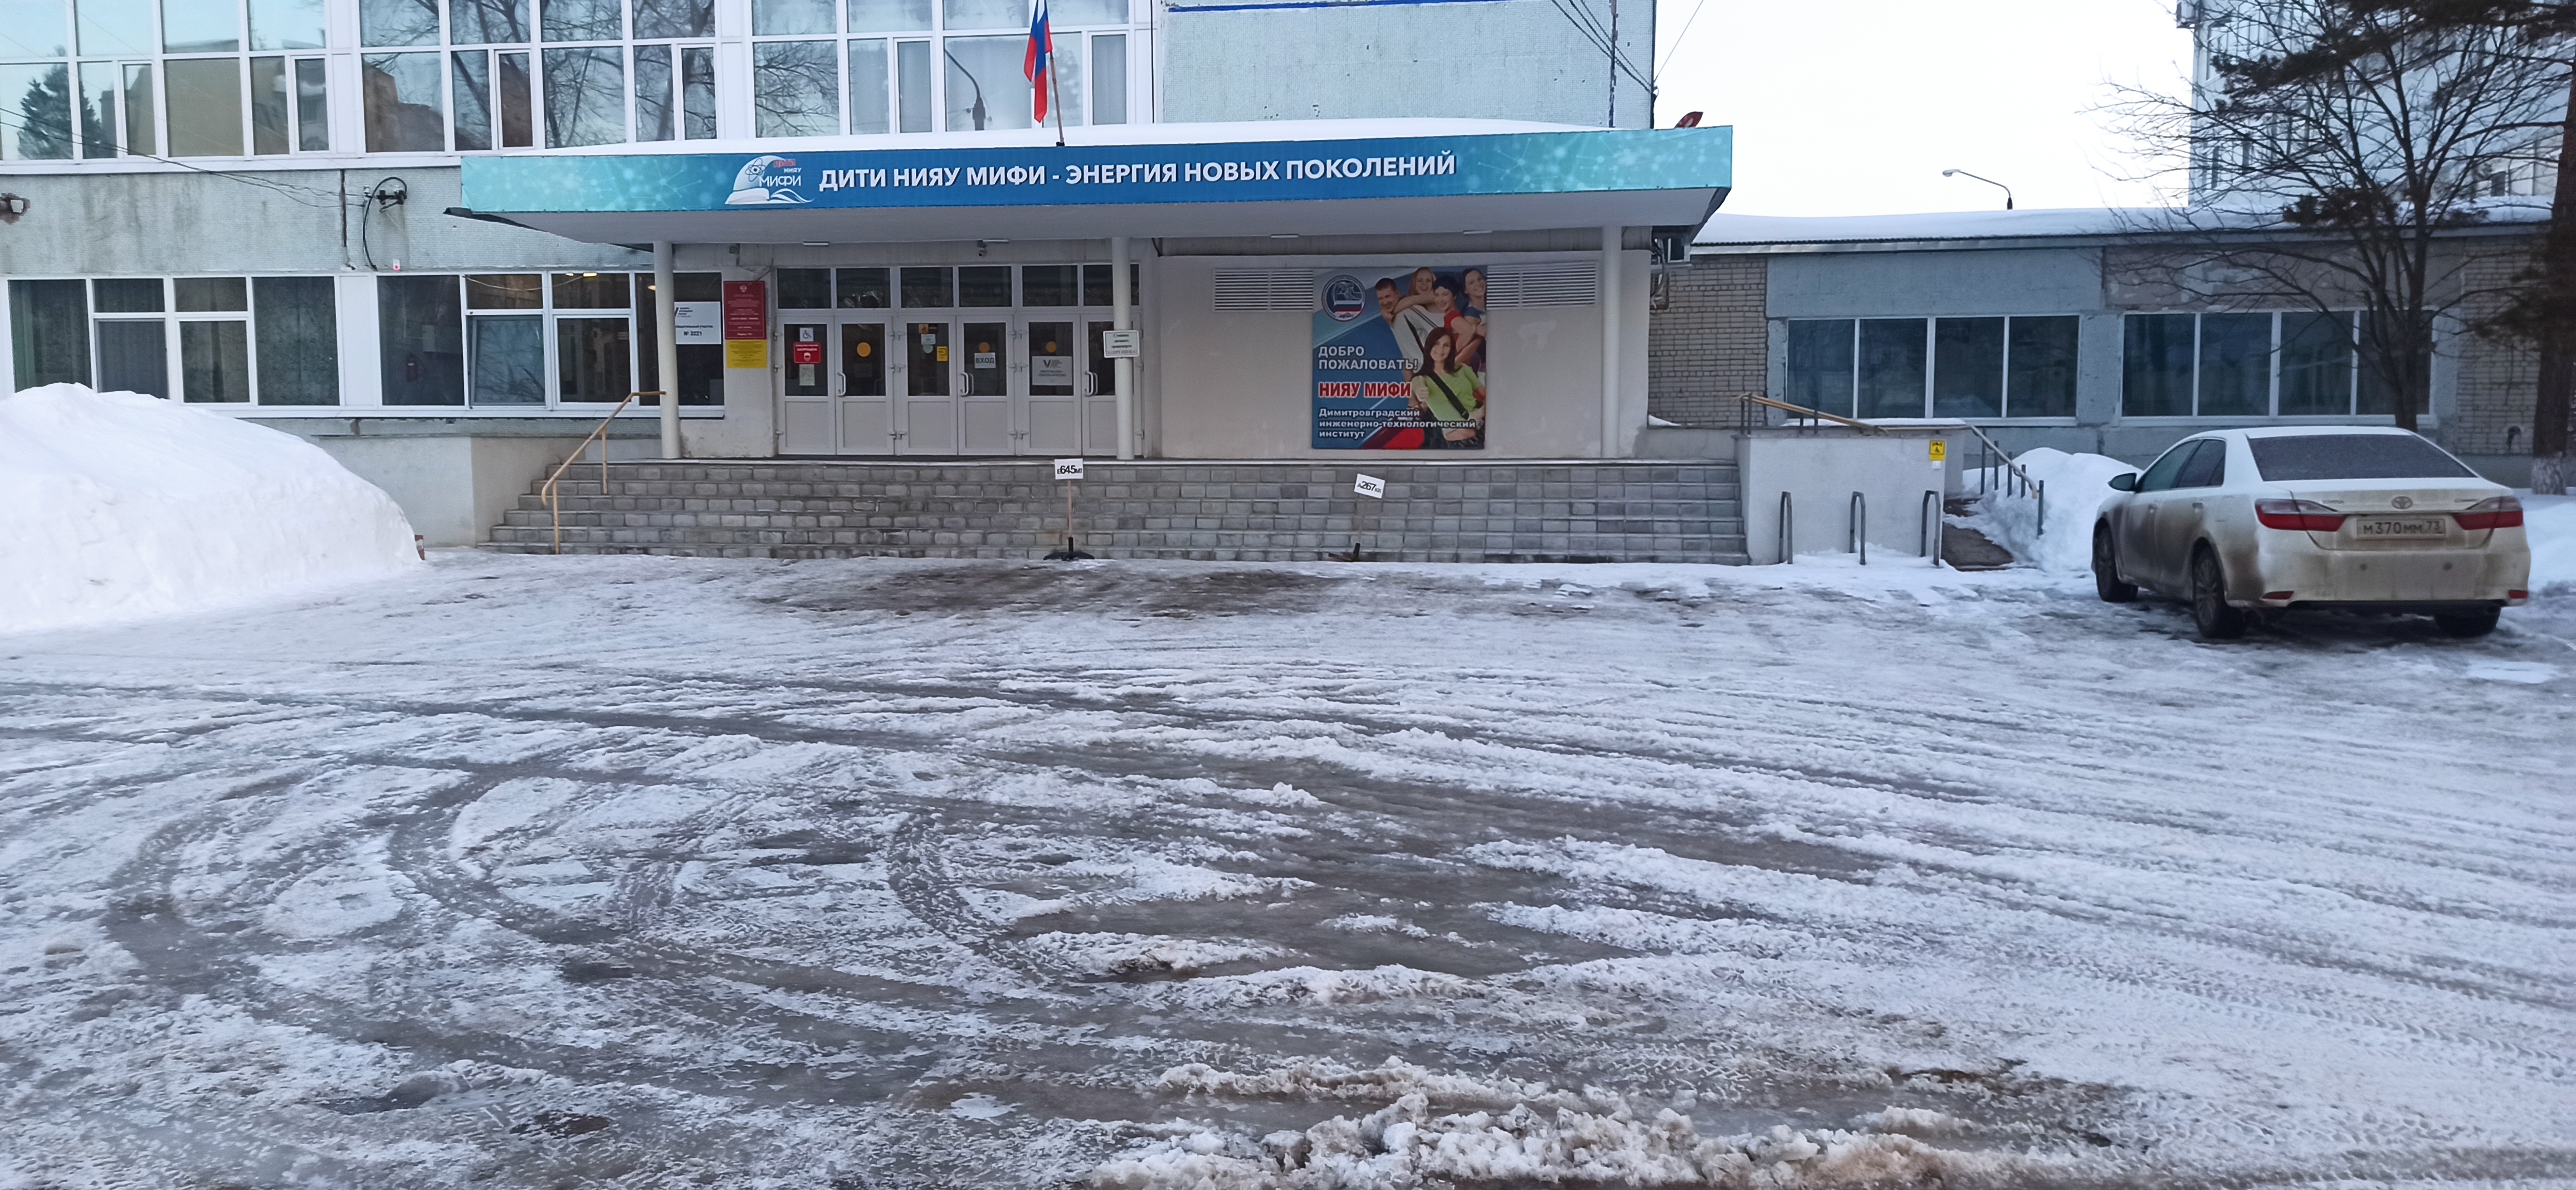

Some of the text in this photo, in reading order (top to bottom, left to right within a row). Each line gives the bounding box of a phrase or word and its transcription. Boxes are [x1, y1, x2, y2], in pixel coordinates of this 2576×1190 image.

[819, 169, 886, 191] ДИТИ
[894, 167, 960, 188] НИЯУ
[967, 165, 1046, 186] МИФИ
[1065, 163, 1177, 184] ЭНЕРГИЯ
[1184, 161, 1280, 182] НОВЫХ
[1286, 150, 1457, 180] ПОКОЛЕНИЙ
[759, 175, 801, 187] МИФИ
[1318, 346, 1365, 358] ДОБРО
[1319, 359, 1418, 370] ПОЖАЛОВАТЬ!
[1318, 382, 1412, 398] НИЯУ МИФИ
[1319, 408, 1420, 418] Димитровградский
[1319, 419, 1476, 428] инженерно-технологический
[1319, 430, 1365, 439] институт
